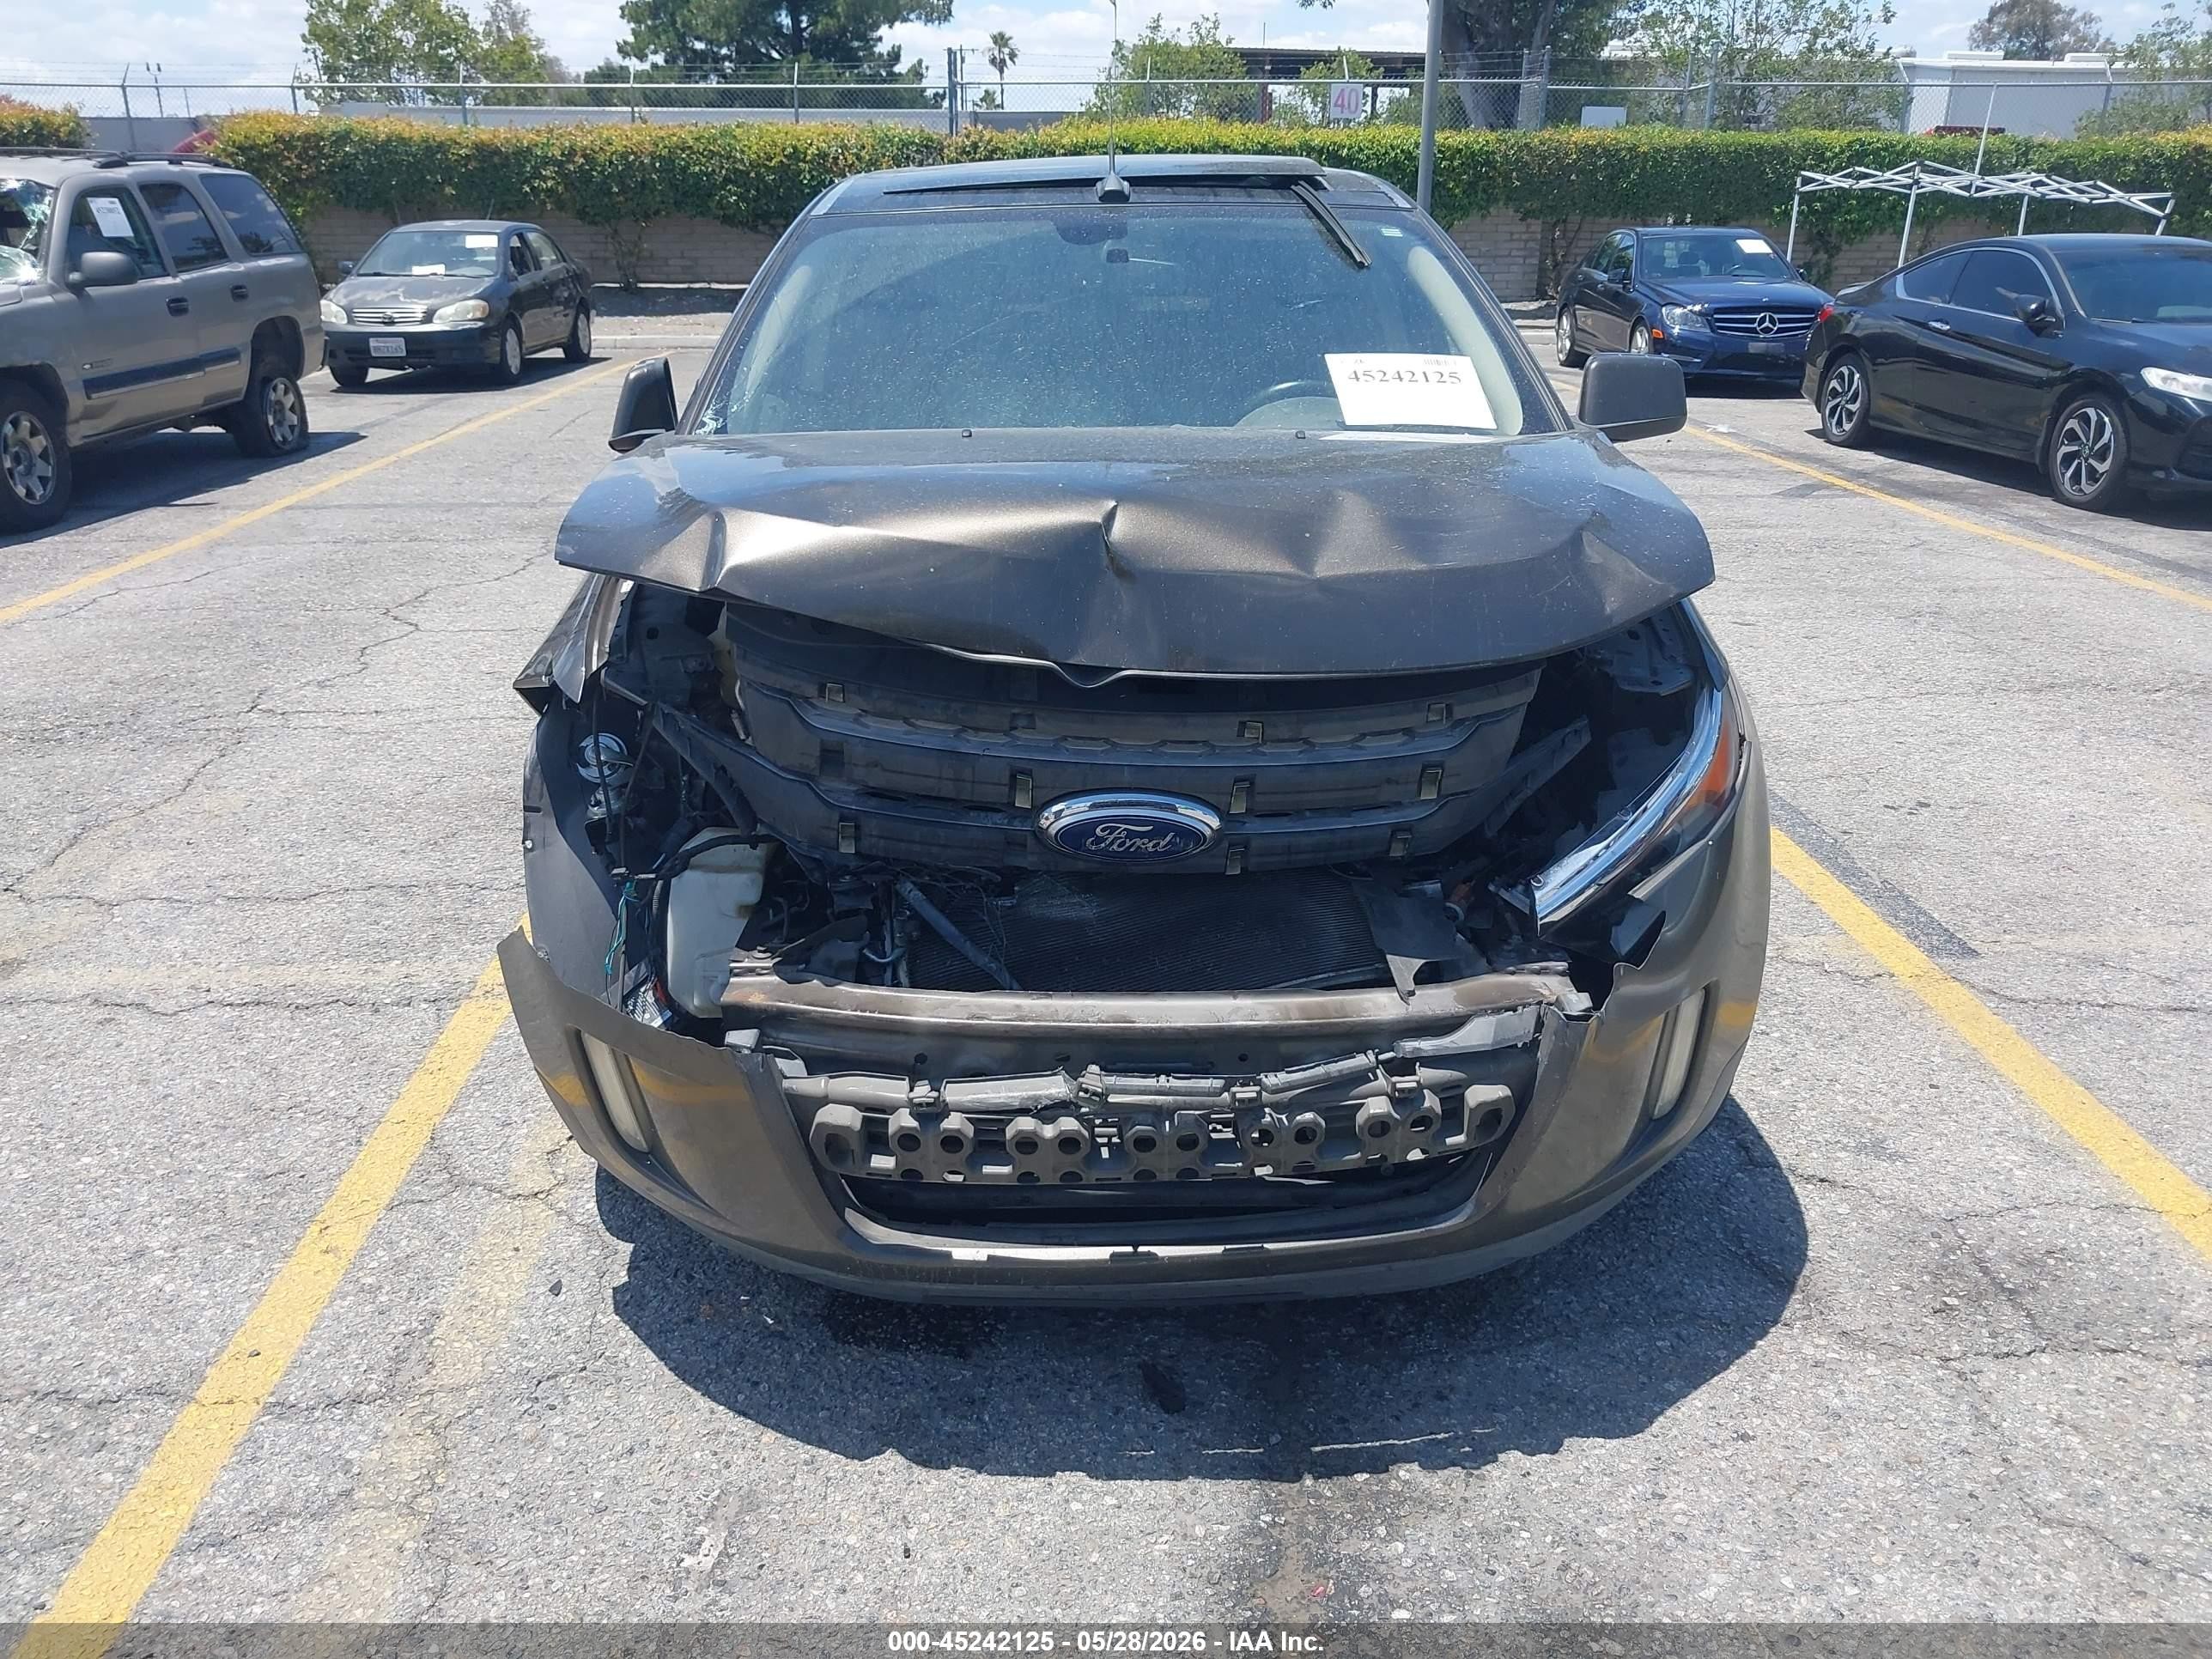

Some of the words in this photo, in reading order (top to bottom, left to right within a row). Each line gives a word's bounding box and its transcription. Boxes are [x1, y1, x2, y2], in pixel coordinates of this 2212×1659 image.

[1334, 88, 1359, 114] 40
[1347, 369, 1462, 385] 45242125
[1085, 822, 1175, 853] Ford
